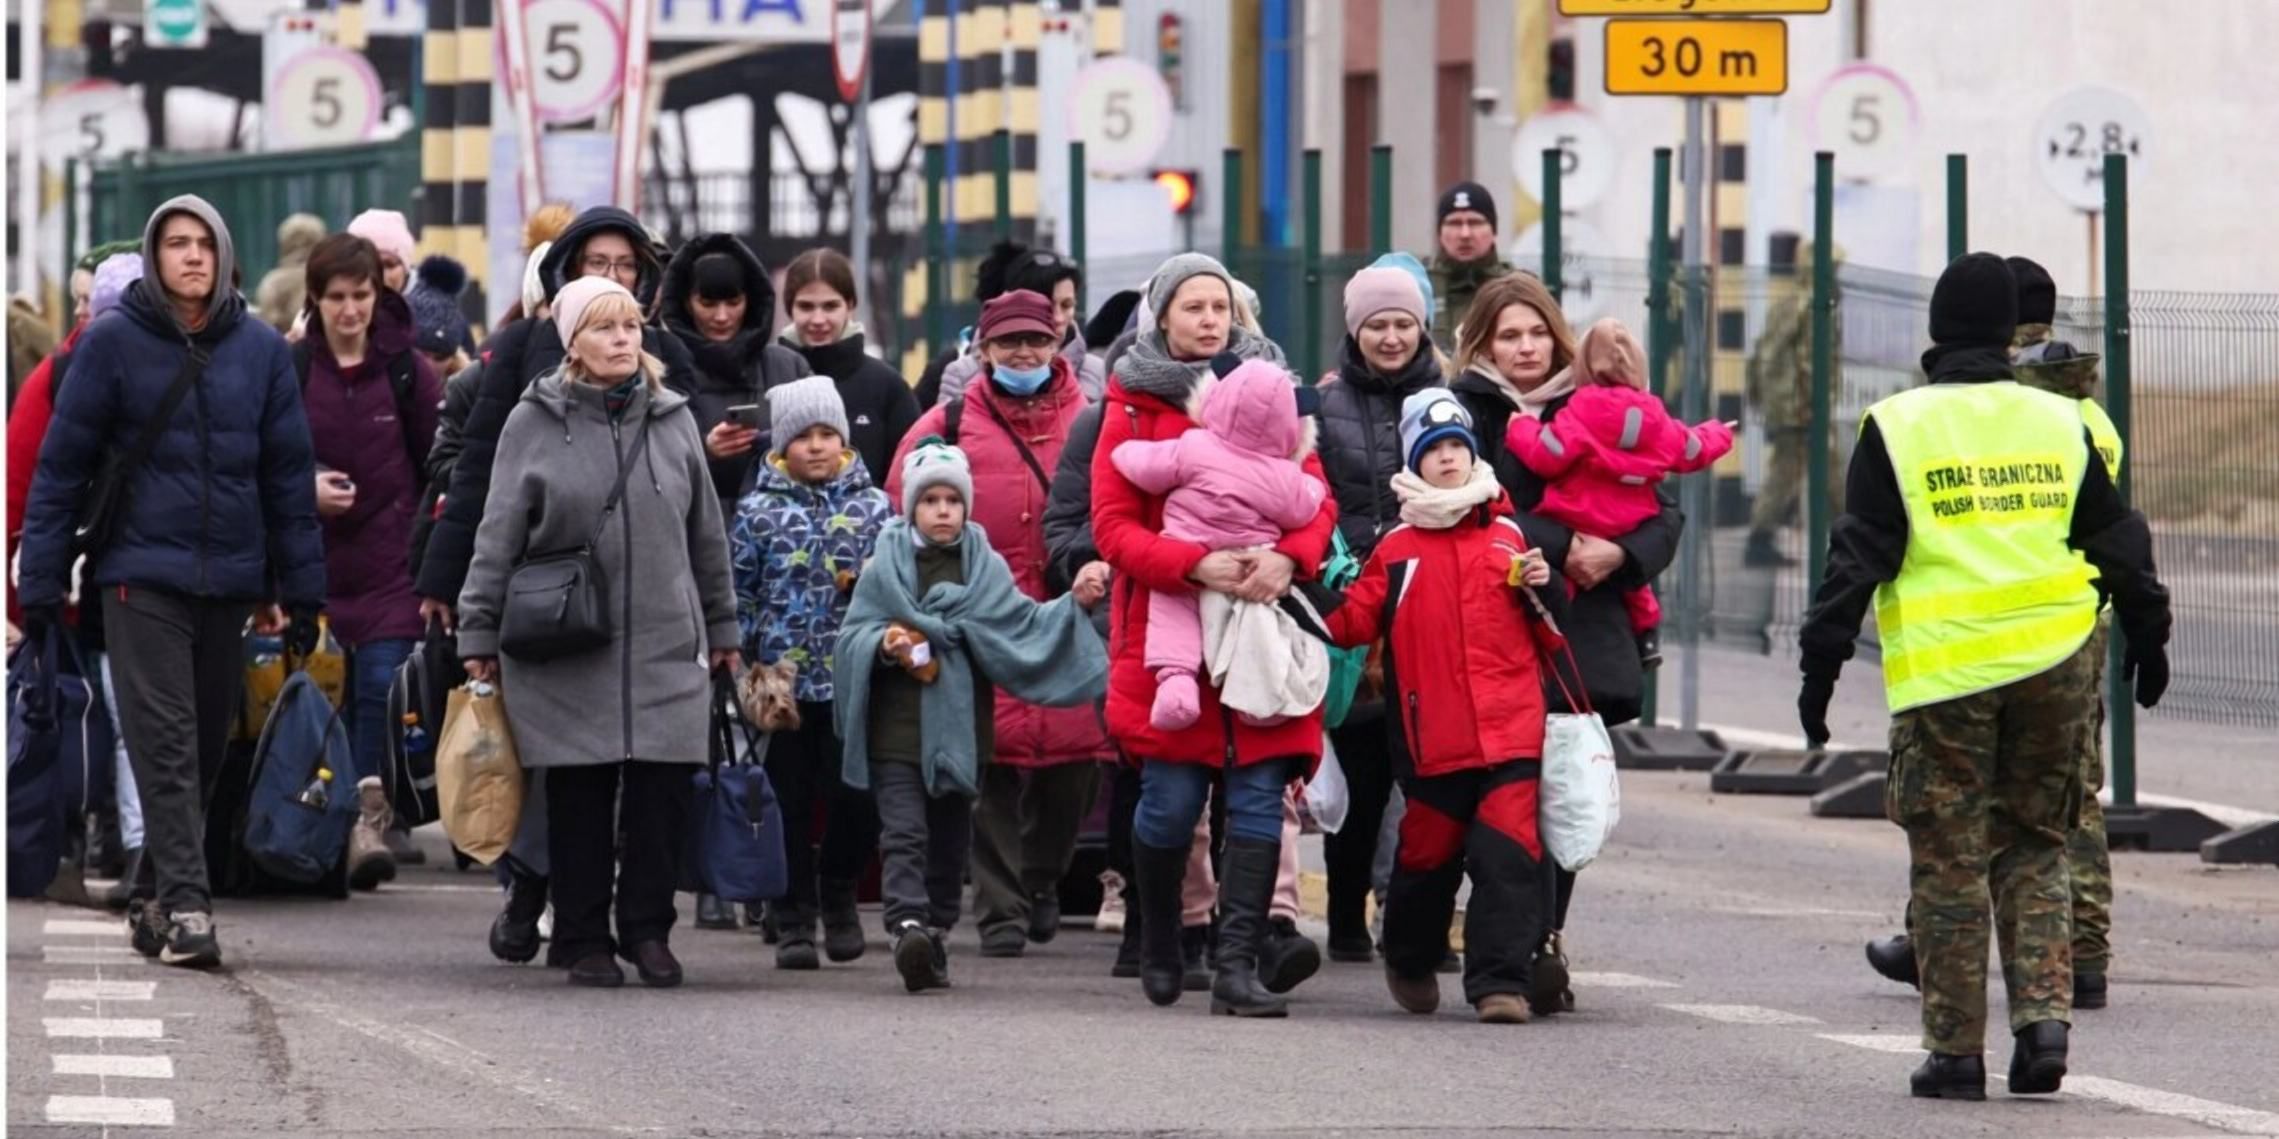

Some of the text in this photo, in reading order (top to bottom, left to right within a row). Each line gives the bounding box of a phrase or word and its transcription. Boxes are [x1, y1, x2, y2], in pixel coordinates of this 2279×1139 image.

[545, 24, 582, 83] 5
[1640, 36, 1757, 77] 30 m
[311, 78, 343, 128] 5
[1103, 91, 1133, 141] 5
[1849, 96, 1881, 145] 5
[1555, 135, 1579, 174] 5
[1979, 463, 2064, 487] GRANICZNA
[1932, 495, 1974, 517] POLISH
[2030, 492, 2068, 509] GUARD
